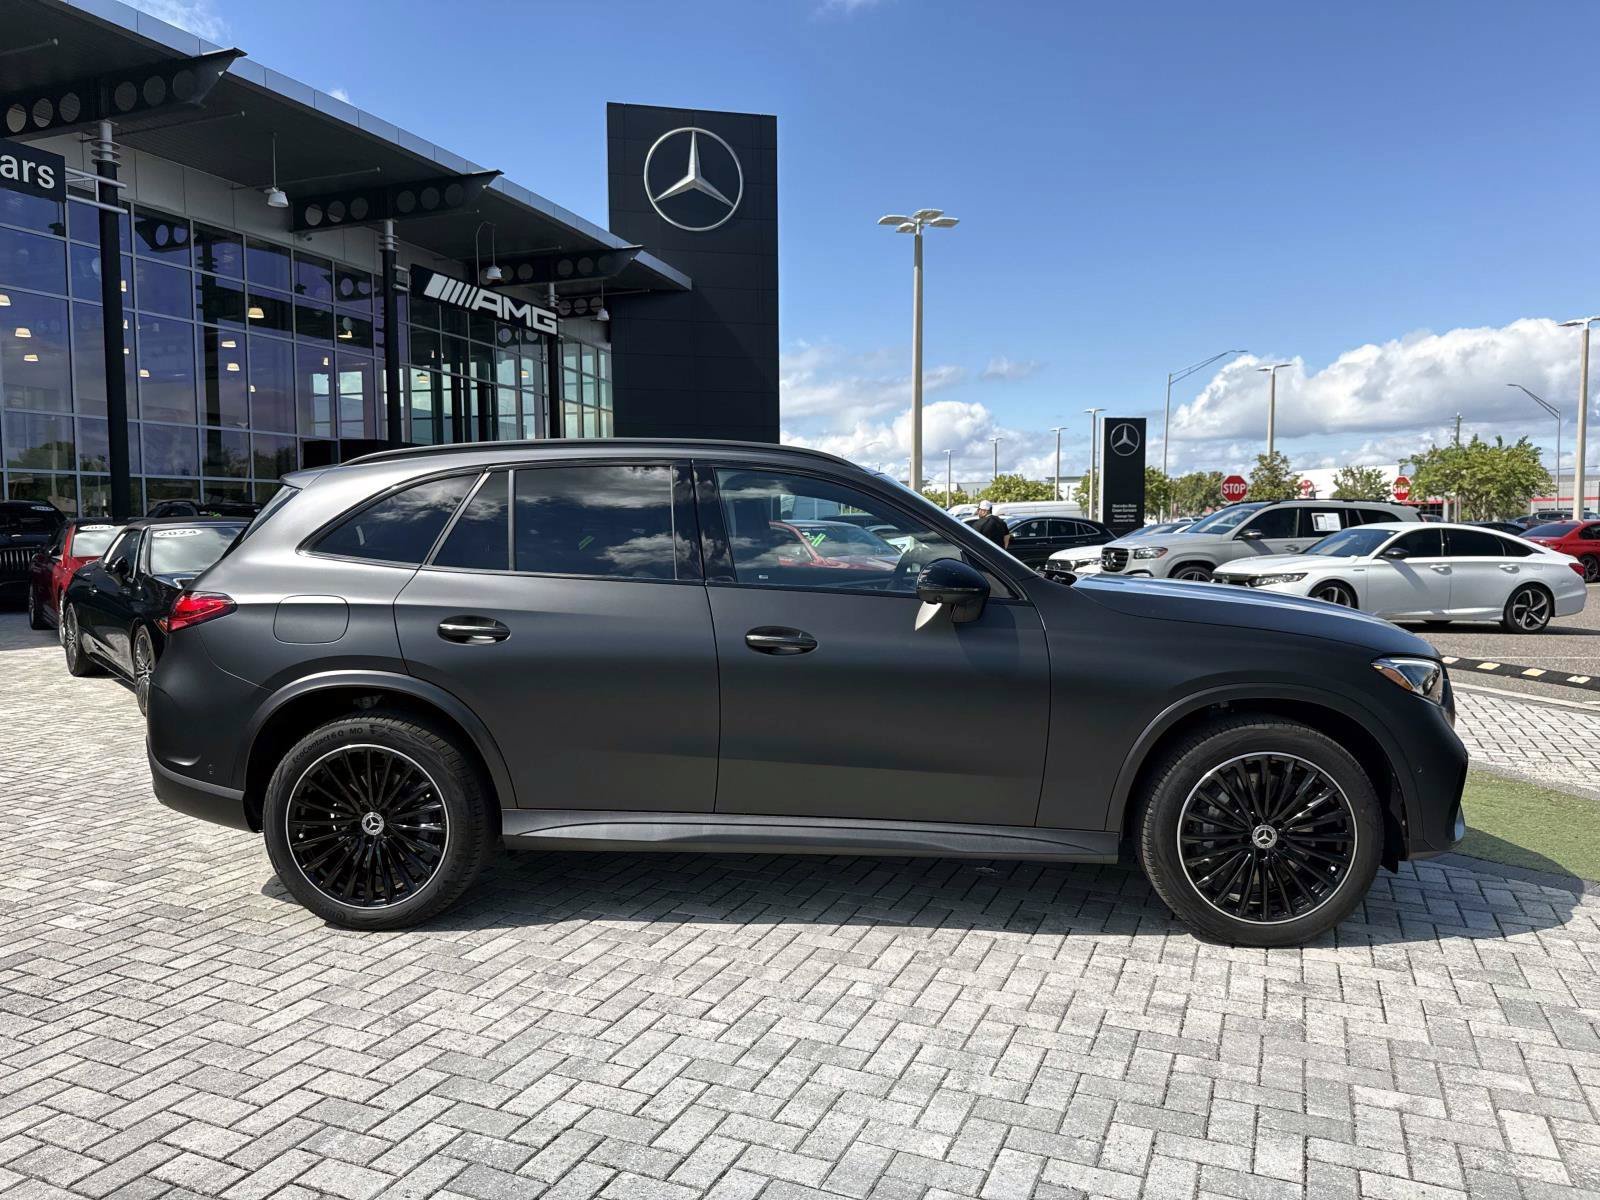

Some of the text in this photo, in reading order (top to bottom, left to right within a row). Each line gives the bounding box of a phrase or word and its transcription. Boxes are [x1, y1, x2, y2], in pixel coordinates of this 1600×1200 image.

[0, 154, 55, 189] ars
[471, 288, 557, 335] AMG
[1223, 484, 1246, 494] STOP
[349, 727, 364, 736] MO
